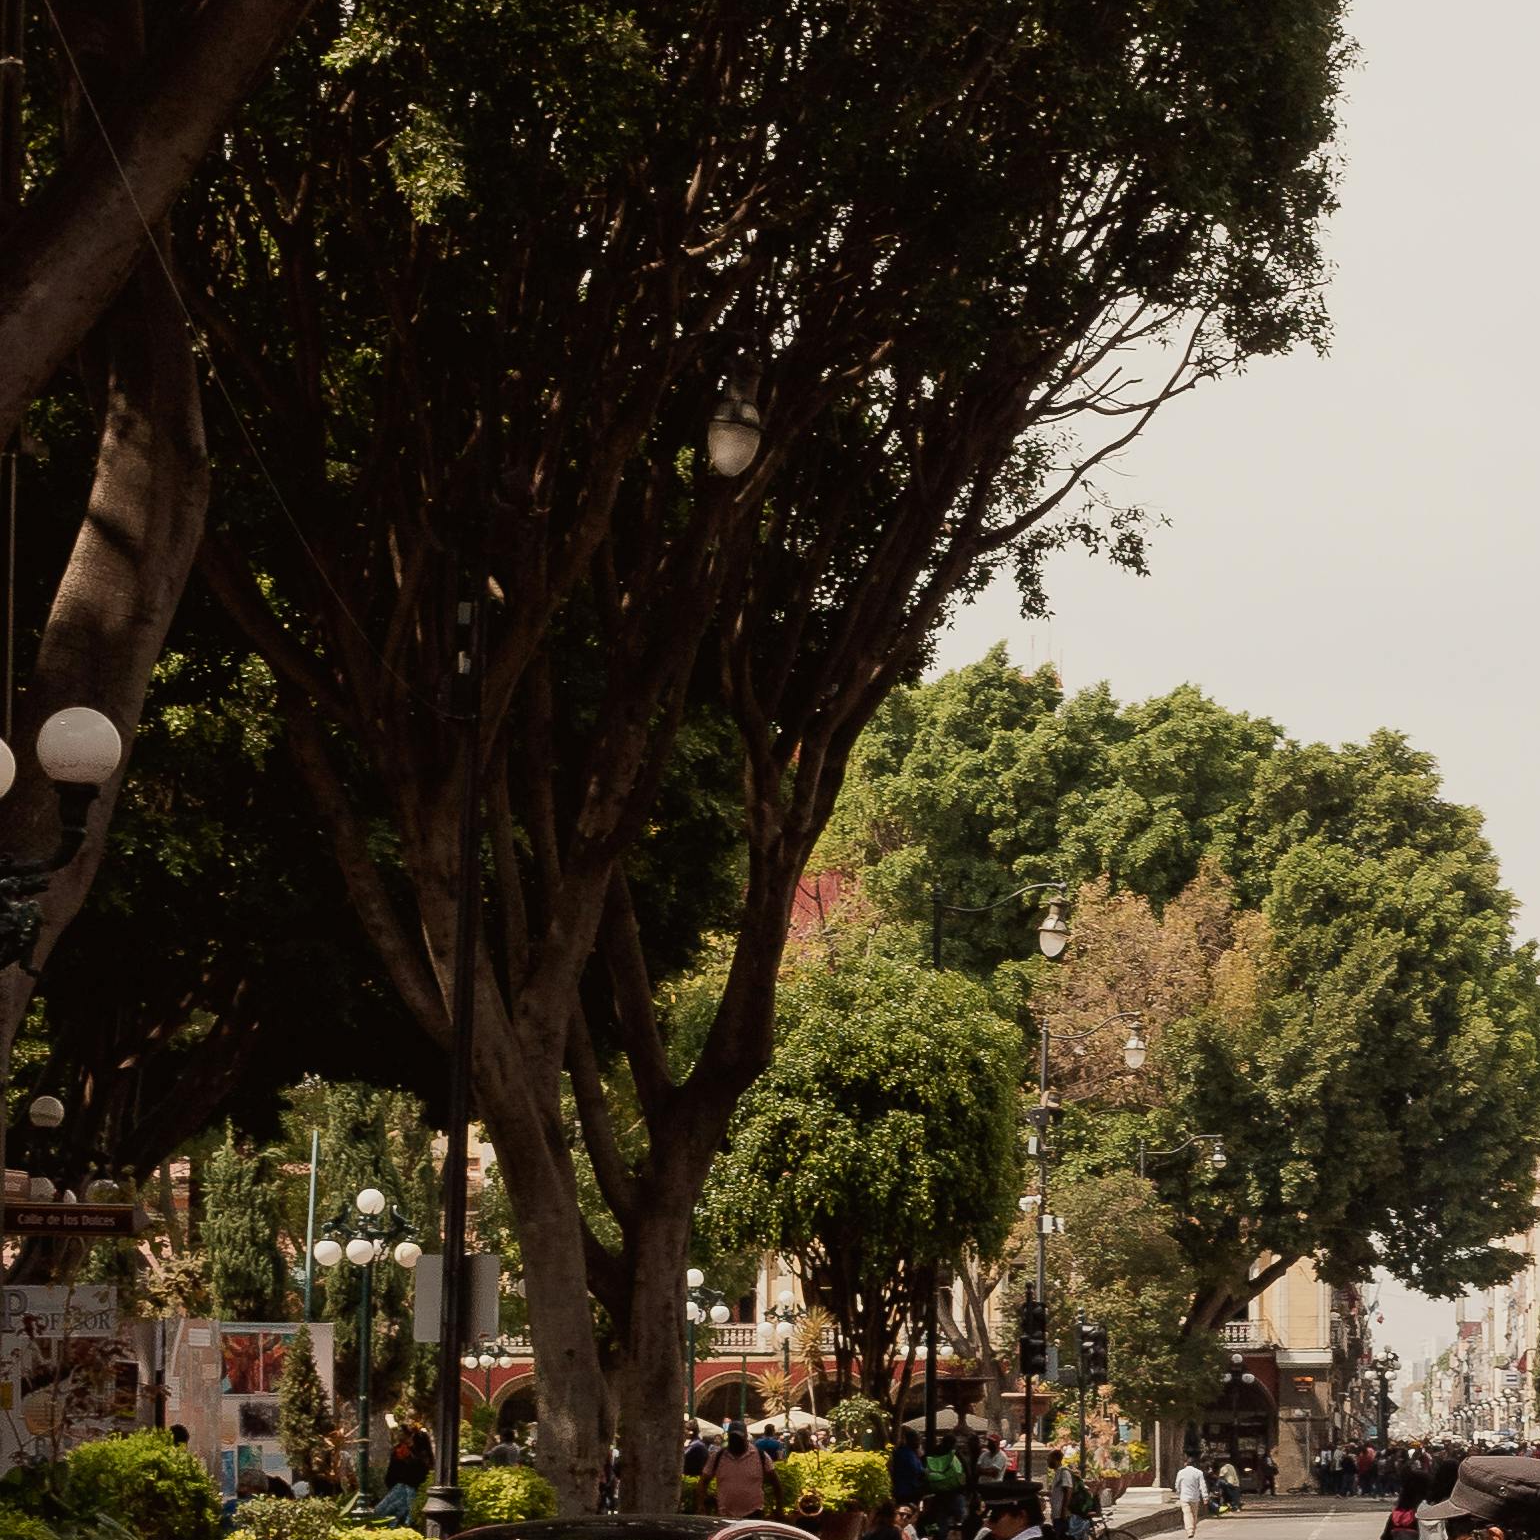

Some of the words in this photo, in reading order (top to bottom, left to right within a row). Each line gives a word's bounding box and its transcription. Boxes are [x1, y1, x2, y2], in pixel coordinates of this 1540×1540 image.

[17, 1213, 44, 1225] Calle
[47, 1214, 61, 1225] de
[64, 1214, 78, 1226] los
[82, 1214, 115, 1227] Dulces
